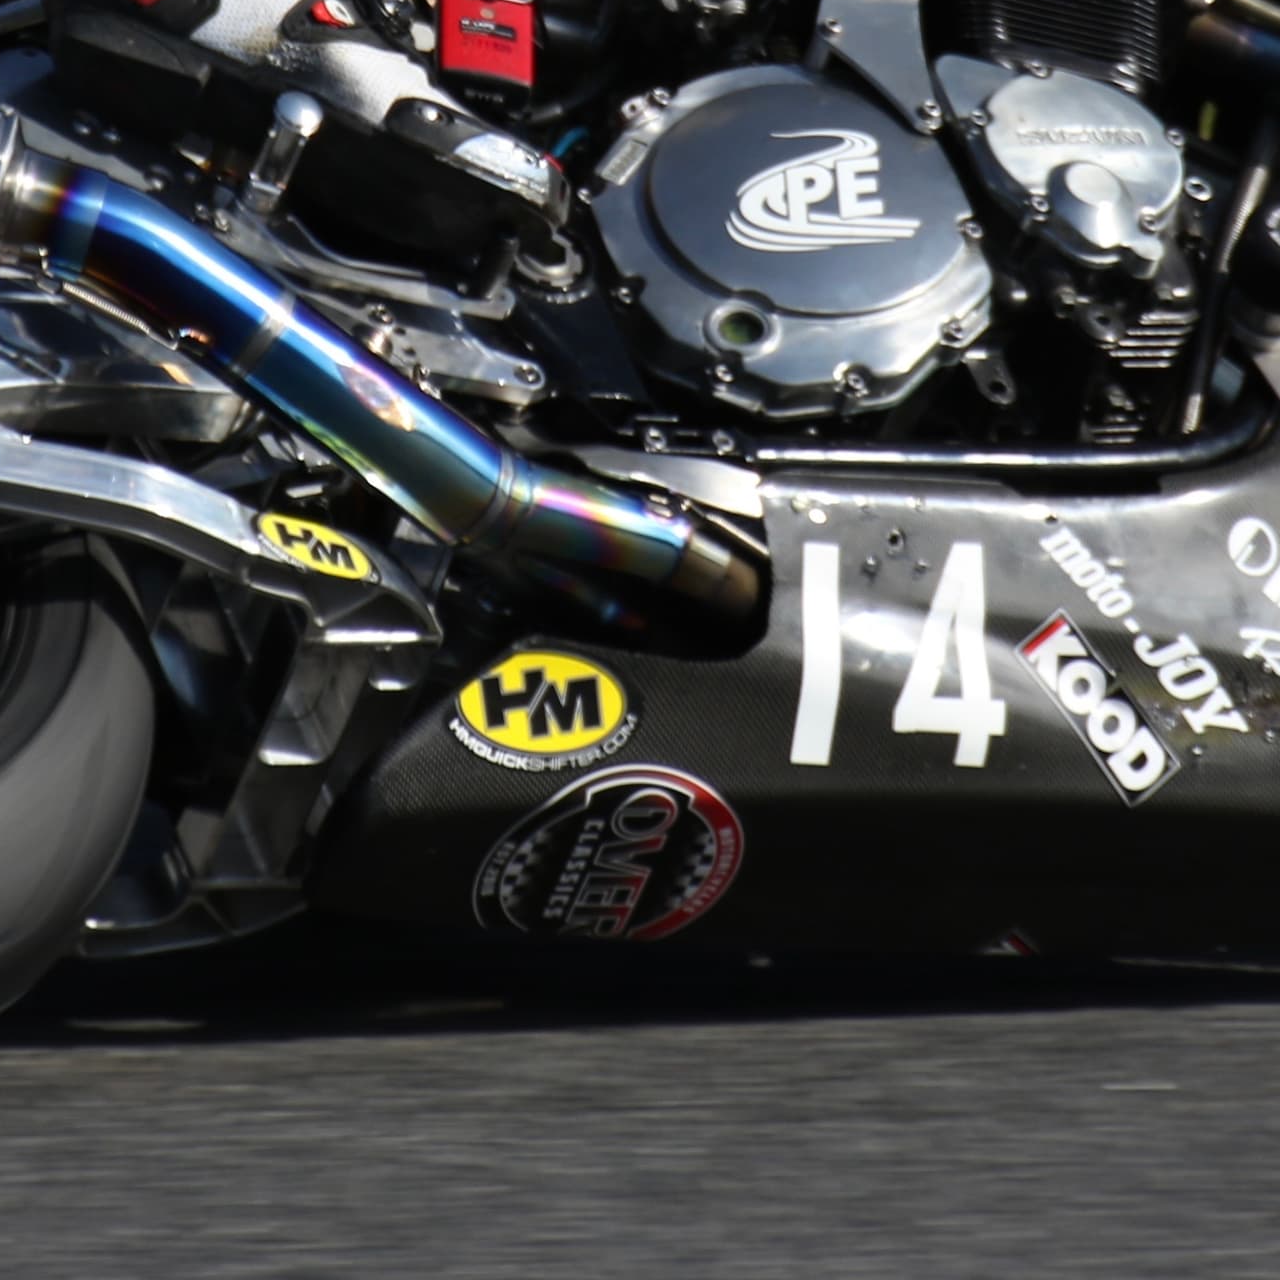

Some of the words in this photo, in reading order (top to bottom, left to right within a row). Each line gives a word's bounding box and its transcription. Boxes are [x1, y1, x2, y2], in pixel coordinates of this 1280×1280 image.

[481, 666, 603, 740] HM
[789, 541, 1008, 768] 14
[1029, 623, 1166, 792] KOOD
[541, 818, 606, 920] CLASSICS
[558, 787, 679, 938] OVER
